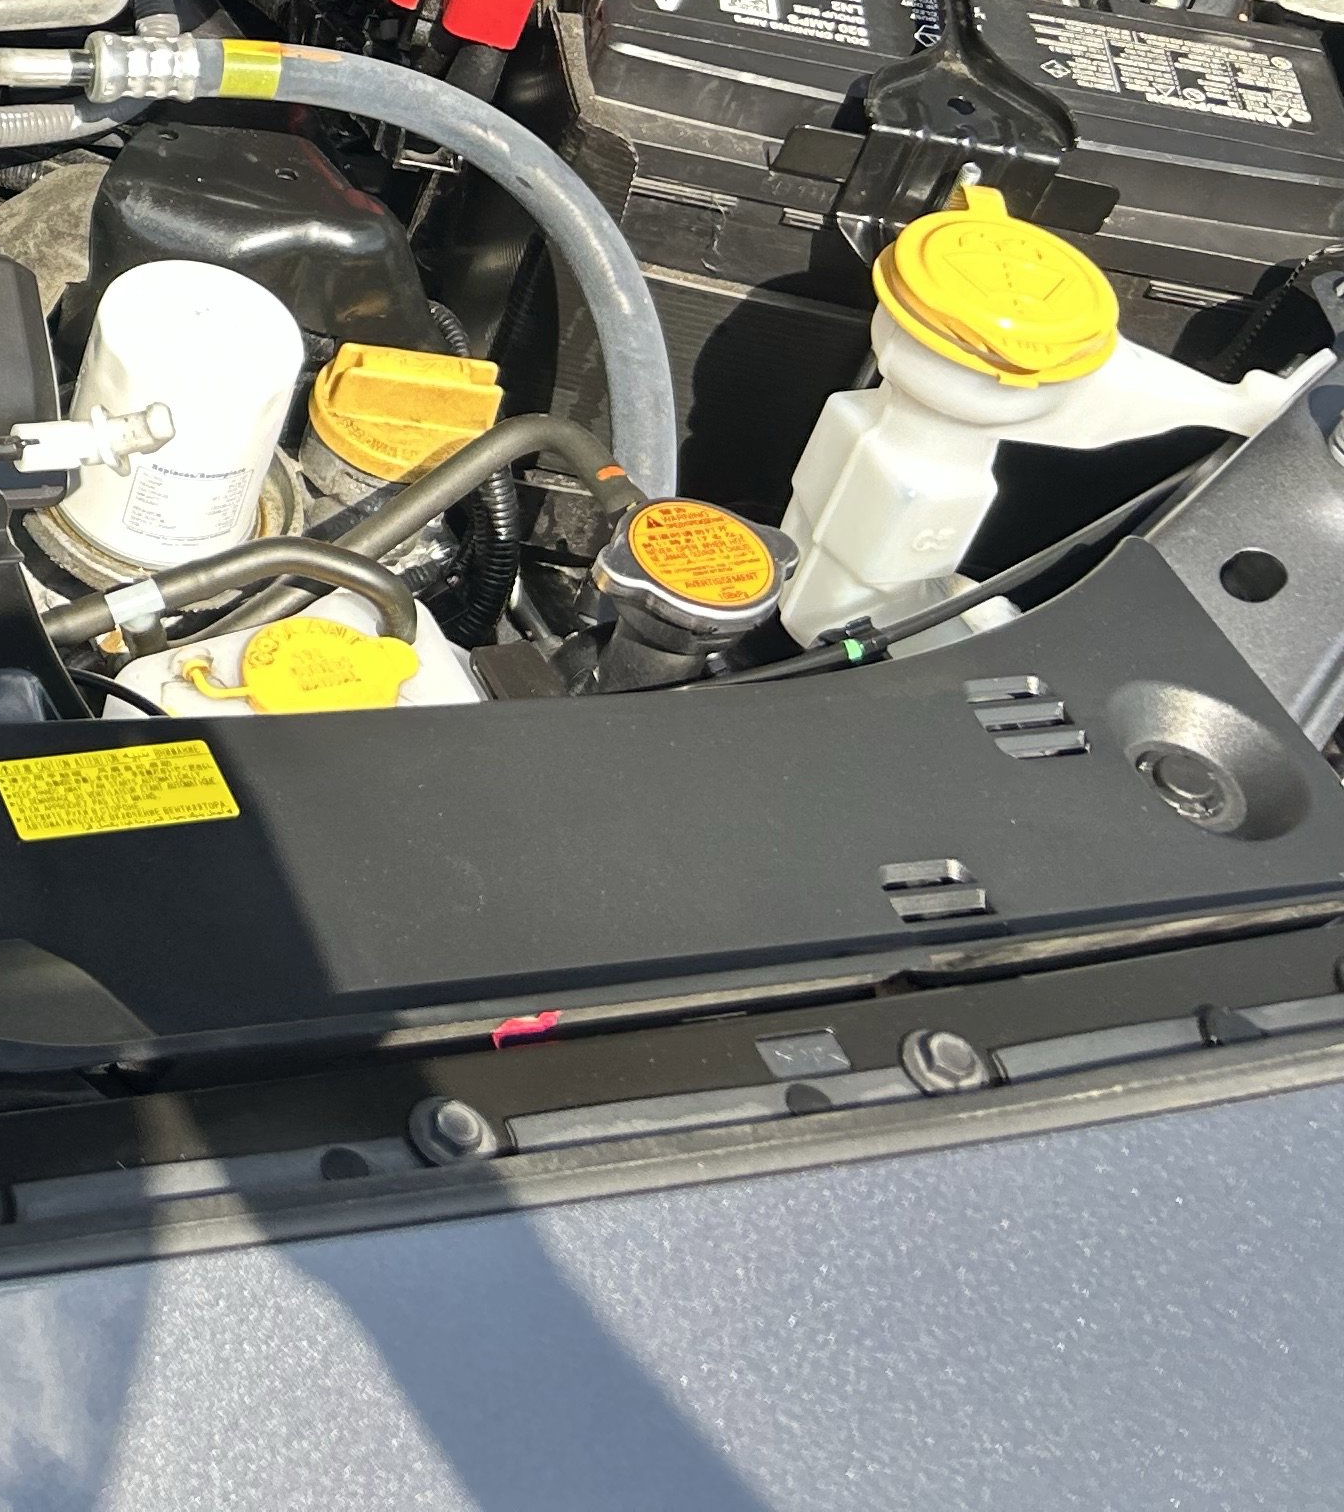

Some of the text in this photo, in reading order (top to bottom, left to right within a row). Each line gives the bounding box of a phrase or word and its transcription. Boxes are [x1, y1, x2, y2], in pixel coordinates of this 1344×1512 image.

[831, 0, 864, 16] LN2
[734, 14, 768, 28] AMPS
[787, 13, 836, 31] AMPS
